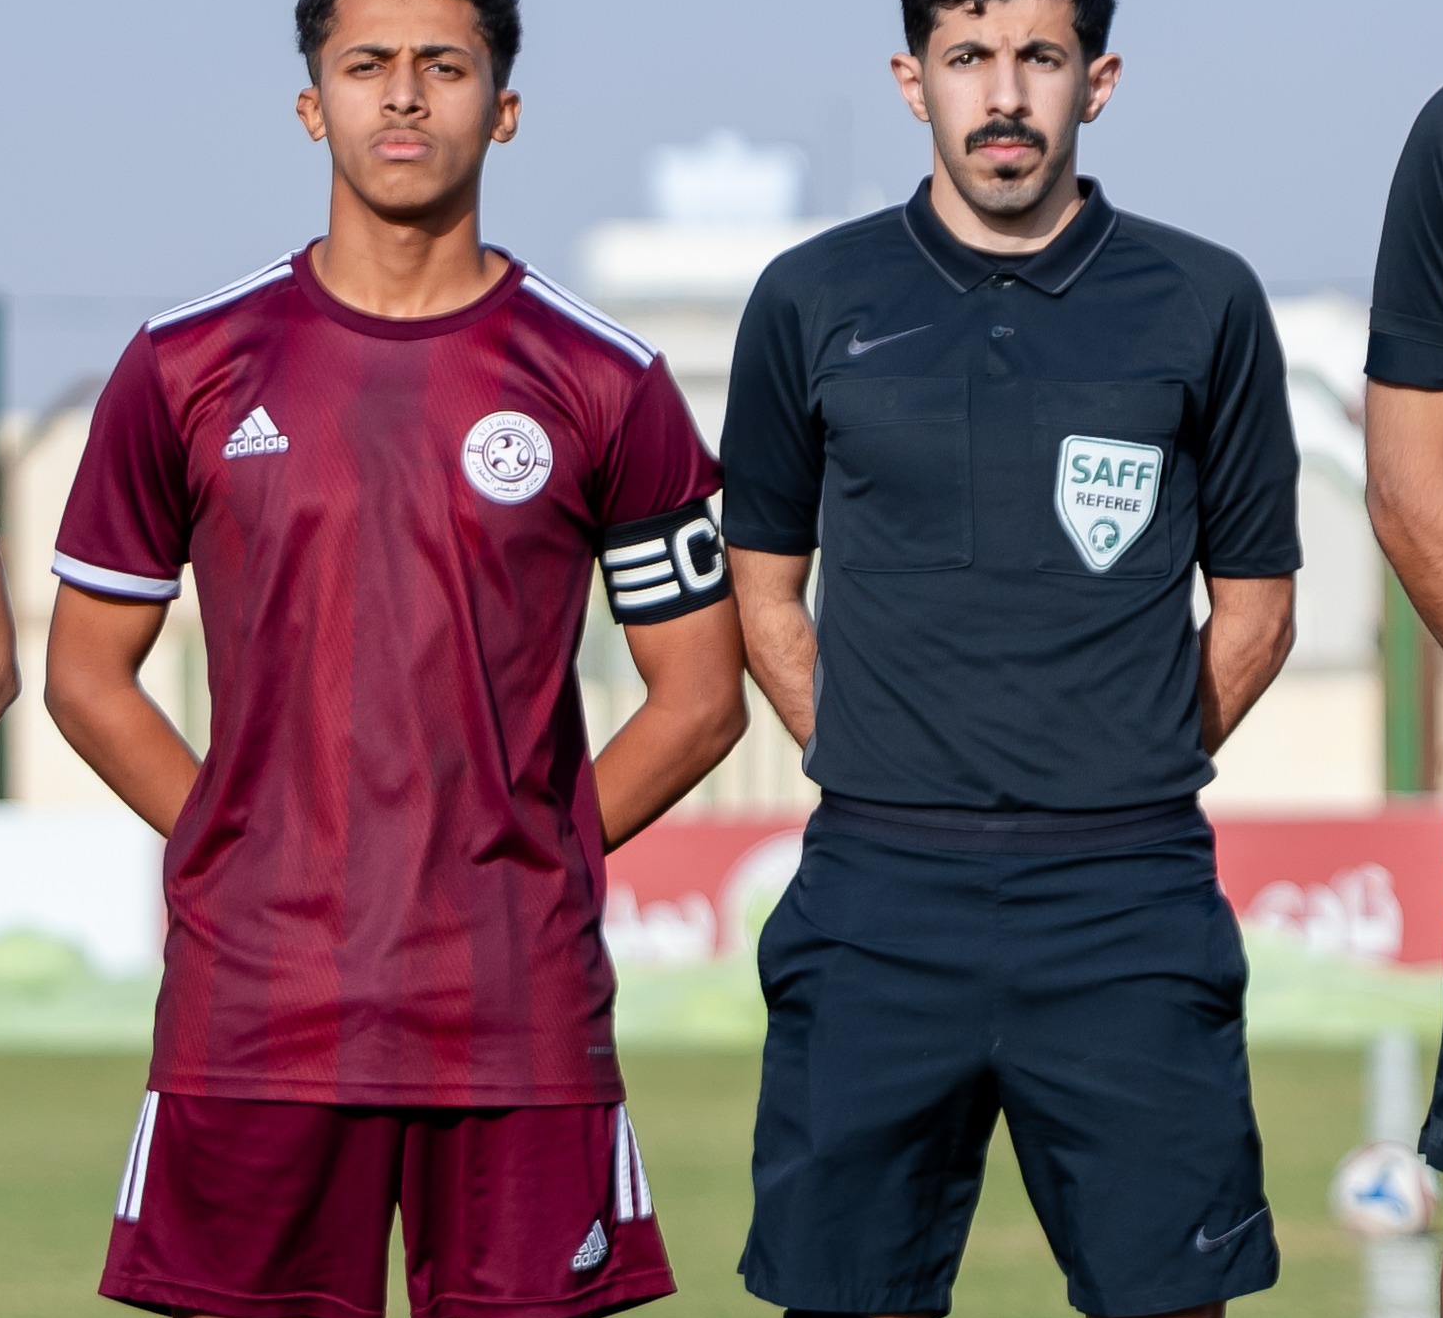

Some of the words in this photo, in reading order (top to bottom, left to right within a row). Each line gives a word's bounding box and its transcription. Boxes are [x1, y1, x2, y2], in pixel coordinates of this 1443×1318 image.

[222, 435, 289, 458] adidas
[1071, 453, 1155, 490] SAFF
[1075, 491, 1142, 513] REFEREE
